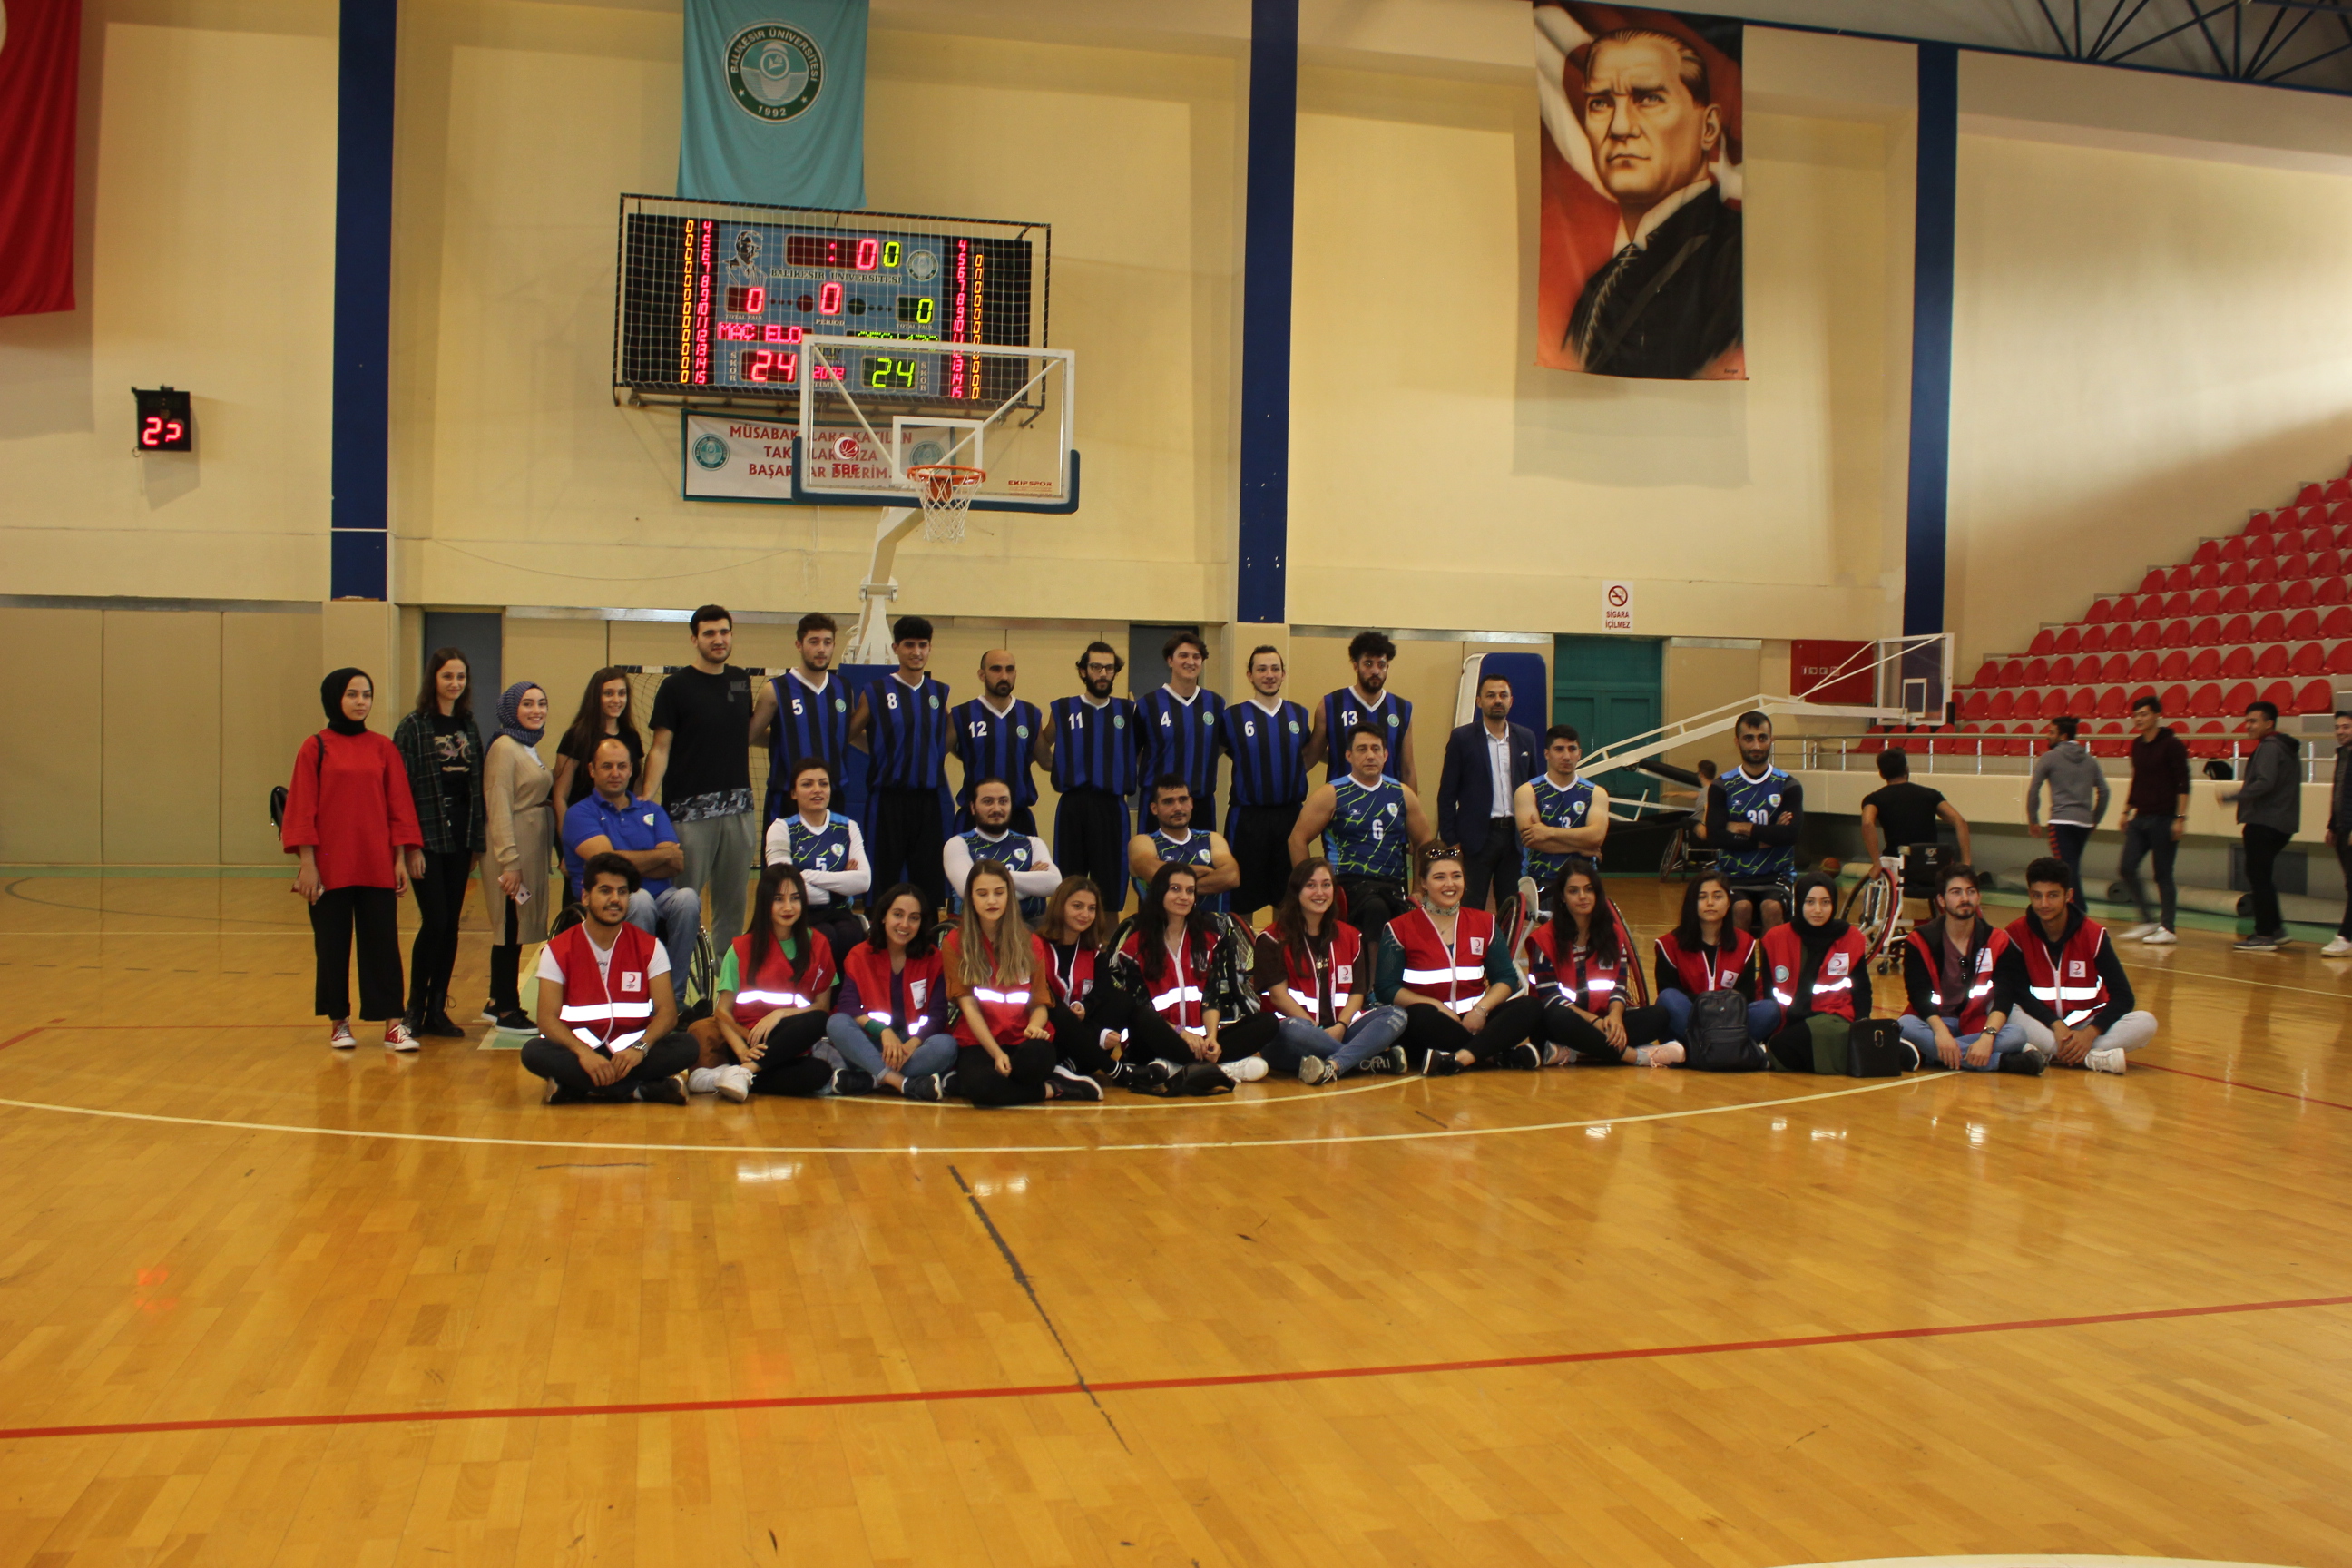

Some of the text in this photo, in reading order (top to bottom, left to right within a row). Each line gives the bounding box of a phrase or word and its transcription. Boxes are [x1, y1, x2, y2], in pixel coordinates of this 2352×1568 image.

[758, 105, 787, 117] 1992
[686, 220, 711, 233] 0 4
[685, 234, 710, 247] 0 5
[958, 240, 967, 251] 4
[685, 248, 710, 260] 0 6
[856, 238, 878, 270] 0
[883, 241, 899, 267] 0
[957, 253, 983, 267] 5 0
[684, 261, 710, 273] 0 7
[957, 267, 965, 279] 6
[684, 275, 710, 288] 0 8
[959, 280, 982, 293] 7 0
[684, 289, 710, 301] 0 9
[746, 287, 765, 314] 0
[818, 282, 843, 316] 0
[956, 293, 981, 307] 8 0
[683, 302, 709, 315] 0 10
[916, 299, 933, 323] 0
[956, 307, 981, 320] 9 0
[682, 316, 709, 328] 0 11
[815, 318, 845, 327] PERIOD
[954, 319, 981, 333] 10 0
[682, 329, 708, 342] 0 12
[681, 343, 707, 356] 0 13
[681, 357, 707, 369] 0 14
[750, 349, 798, 382] 24
[953, 359, 980, 373] 13 0
[681, 370, 706, 384] 0 15
[871, 358, 915, 388] 24
[919, 361, 927, 391] SKOR
[953, 373, 979, 387] 14 0
[952, 386, 979, 399] 15 0
[1606, 609, 1630, 618] SİGARA
[1605, 619, 1631, 630] İÇİLMEZ
[791, 698, 804, 715] 5
[887, 692, 898, 709] 8
[1068, 711, 1083, 730] 11
[1160, 711, 1171, 727] 4
[1341, 710, 1358, 727] 13
[969, 721, 987, 738] 12
[1244, 721, 1255, 737] 6
[1372, 819, 1384, 840] 6
[816, 857, 827, 871] 5
